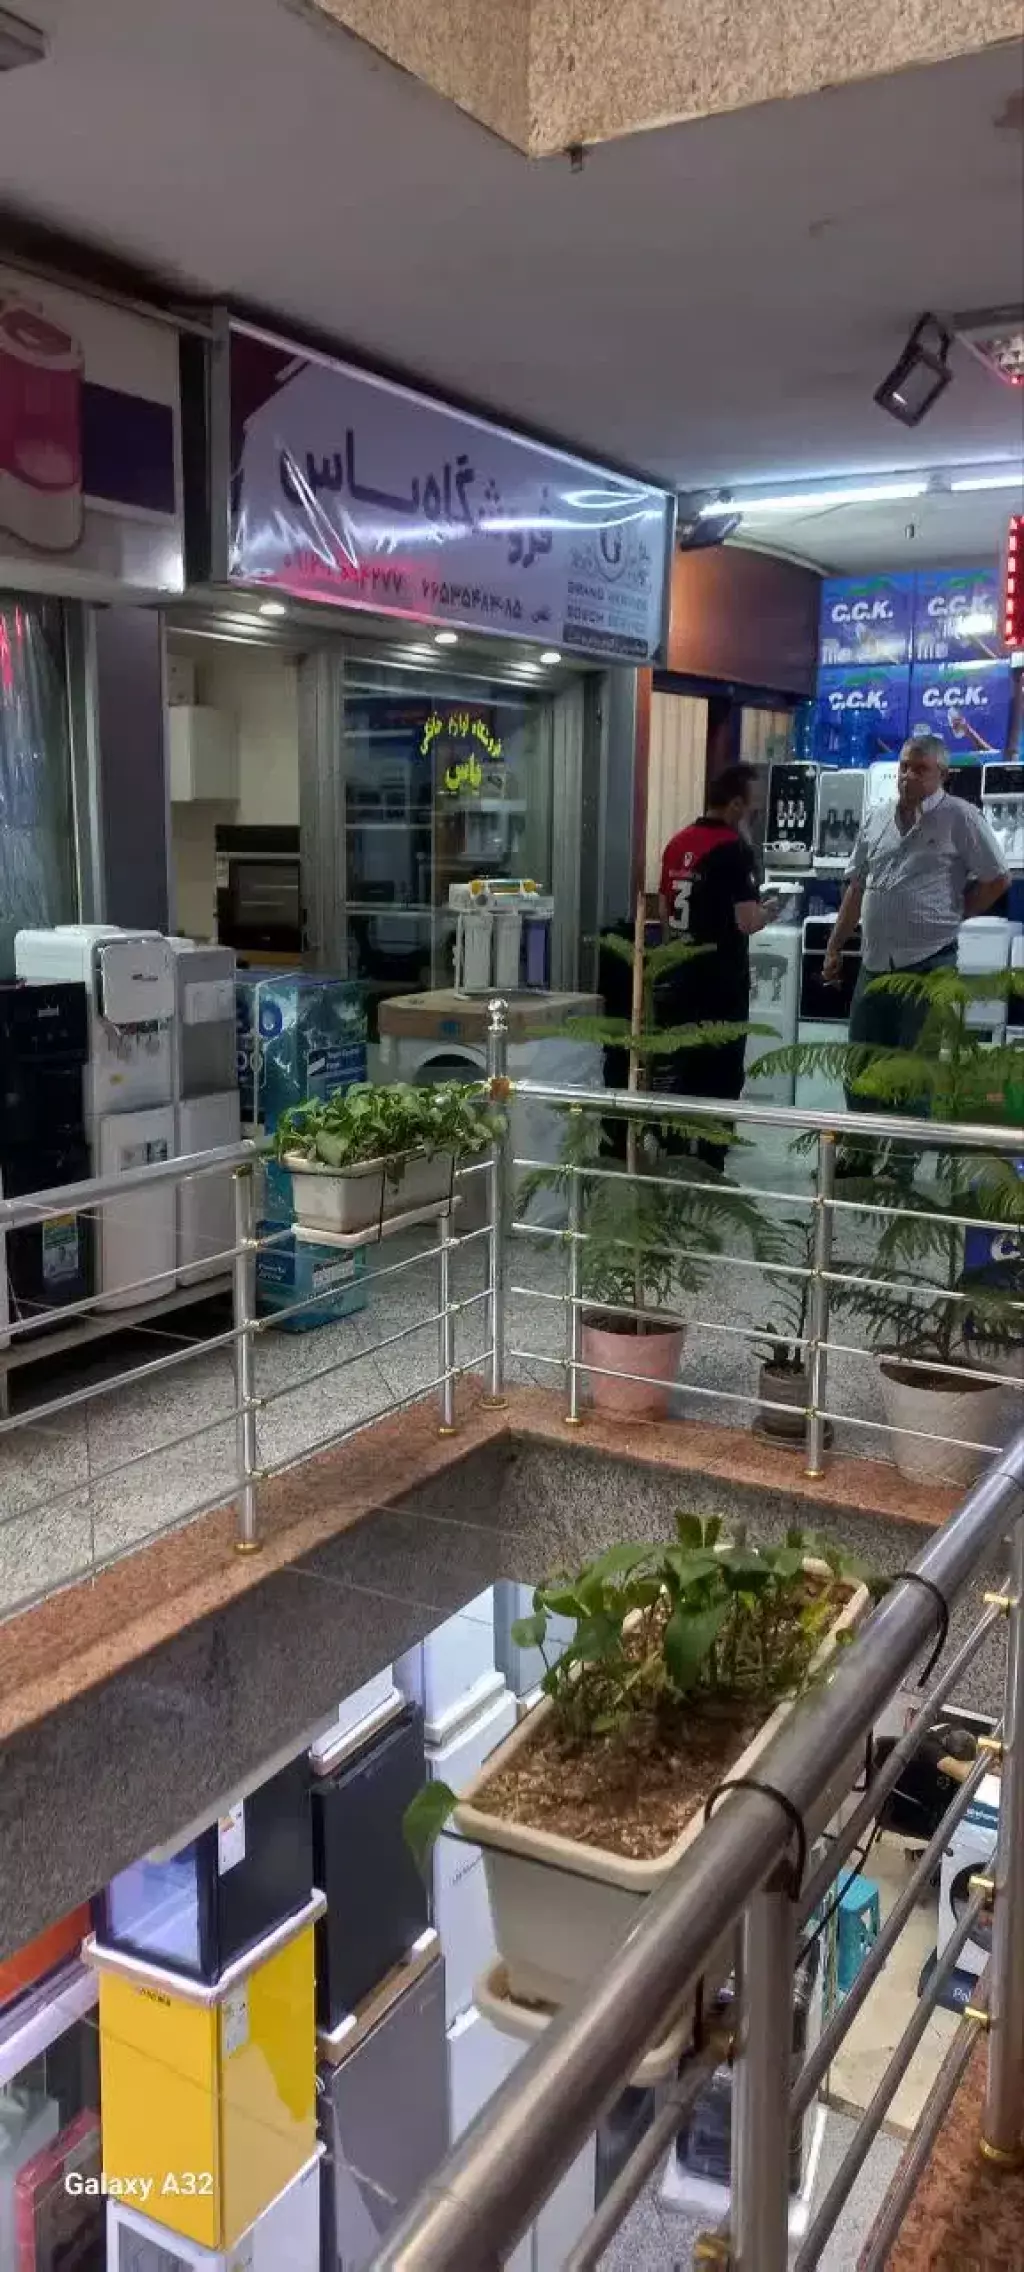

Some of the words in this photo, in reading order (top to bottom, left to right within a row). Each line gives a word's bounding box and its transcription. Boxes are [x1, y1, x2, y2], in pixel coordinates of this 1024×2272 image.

[832, 600, 893, 622] C.C.K.
[928, 595, 992, 616] C.C.K.
[829, 690, 888, 710] C.C.K.
[922, 686, 988, 707] C.C.K.
[668, 880, 692, 930] 3
